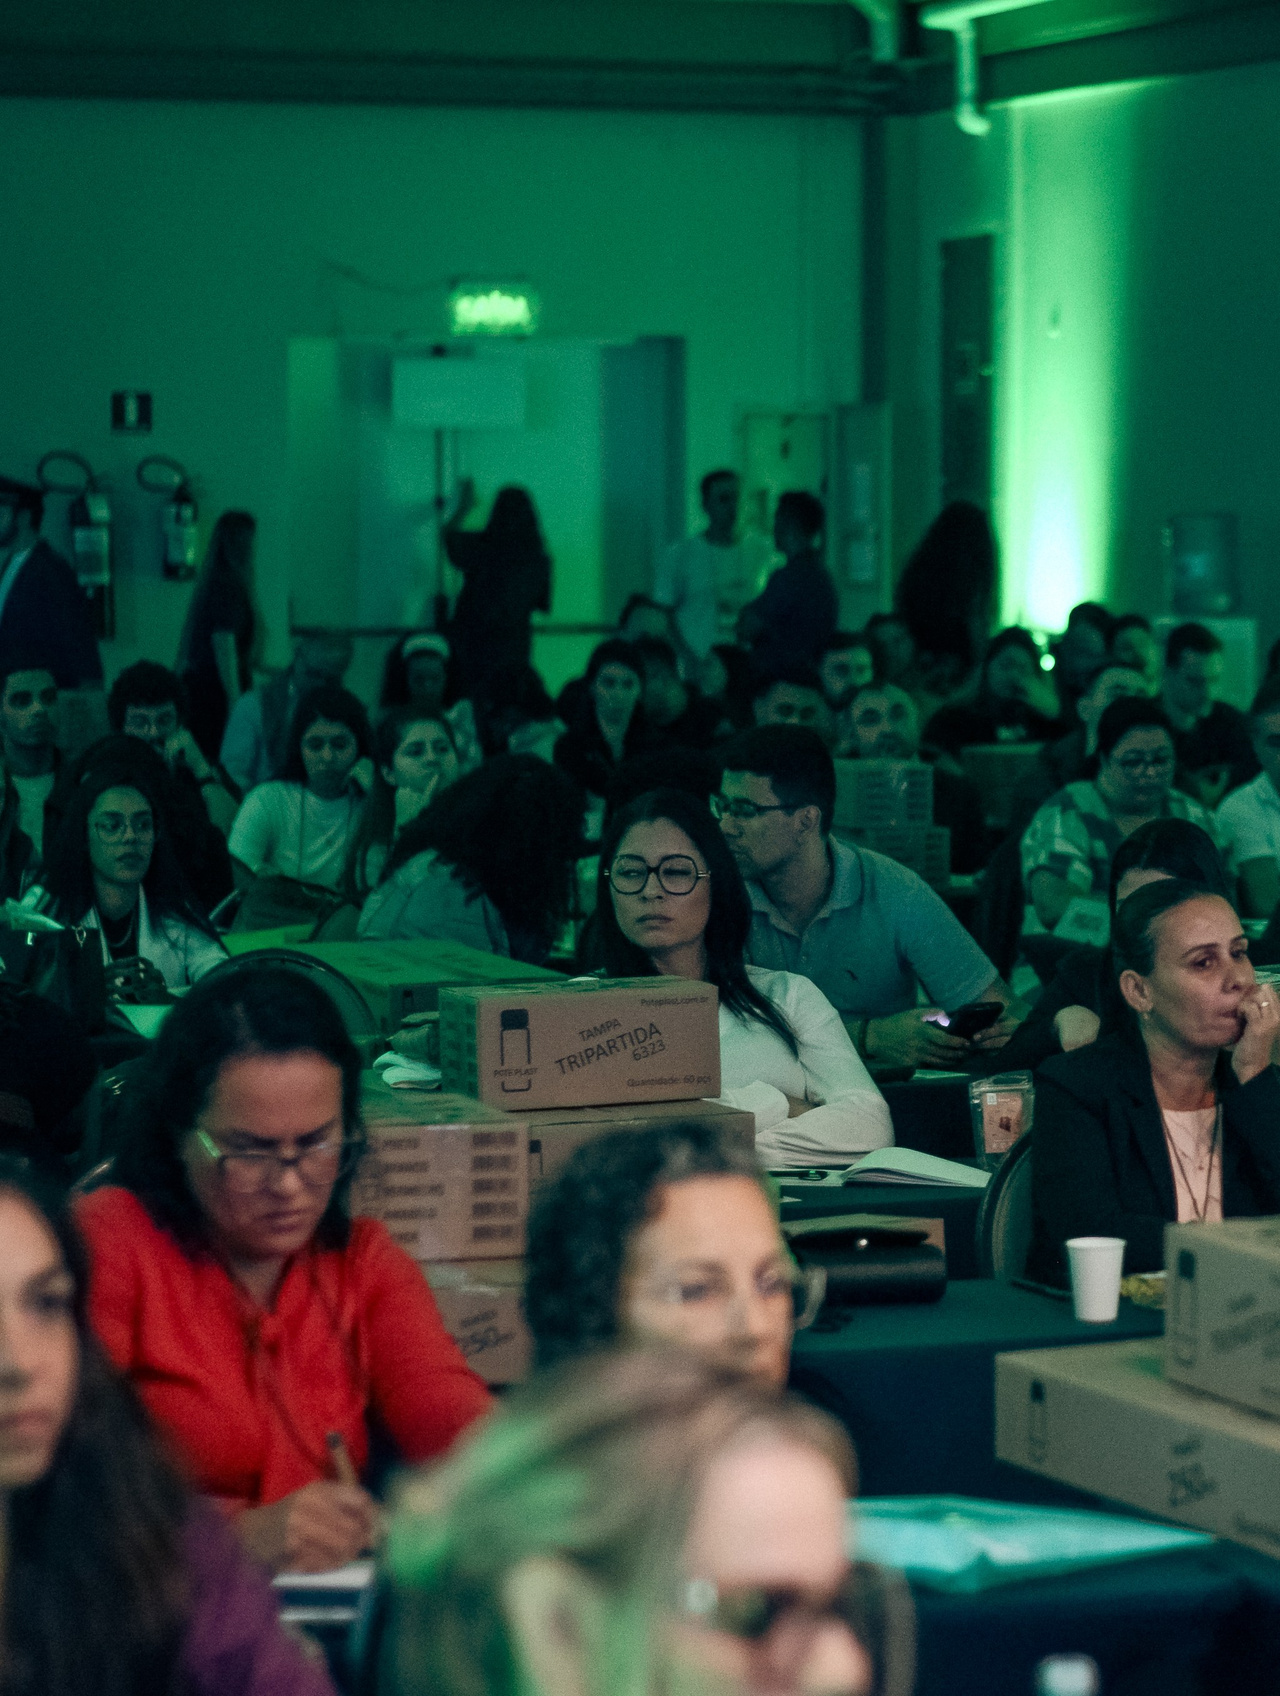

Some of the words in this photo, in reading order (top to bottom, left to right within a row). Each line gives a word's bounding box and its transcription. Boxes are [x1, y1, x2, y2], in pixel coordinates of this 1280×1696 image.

[579, 1018, 622, 1042] TAMPA
[554, 1022, 663, 1075] TRIPARTIDA
[632, 1039, 667, 1061] 6323
